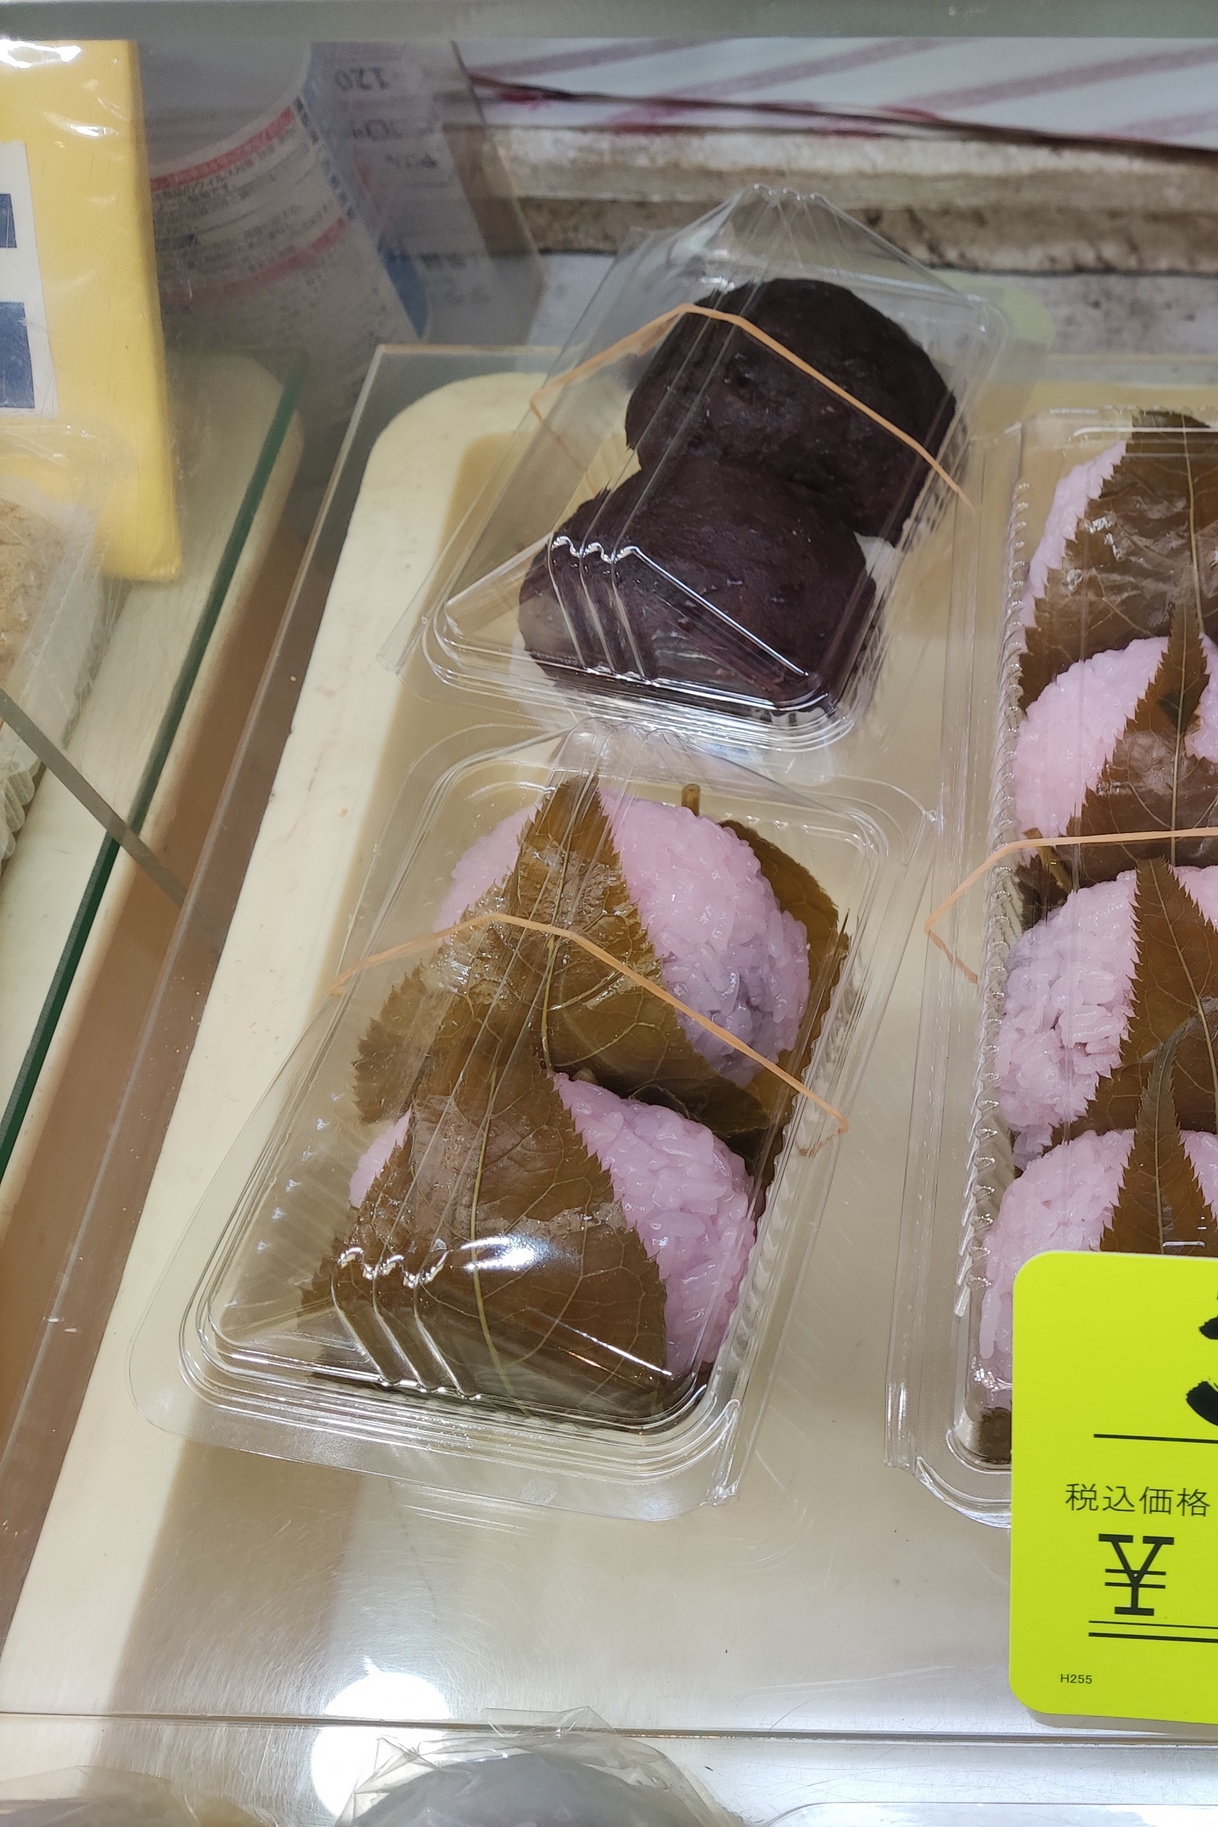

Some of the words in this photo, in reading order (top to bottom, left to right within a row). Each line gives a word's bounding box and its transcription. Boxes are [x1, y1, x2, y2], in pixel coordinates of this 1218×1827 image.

[1065, 1482, 1211, 1518] 税込価格
[1060, 1673, 1093, 1684] H255
